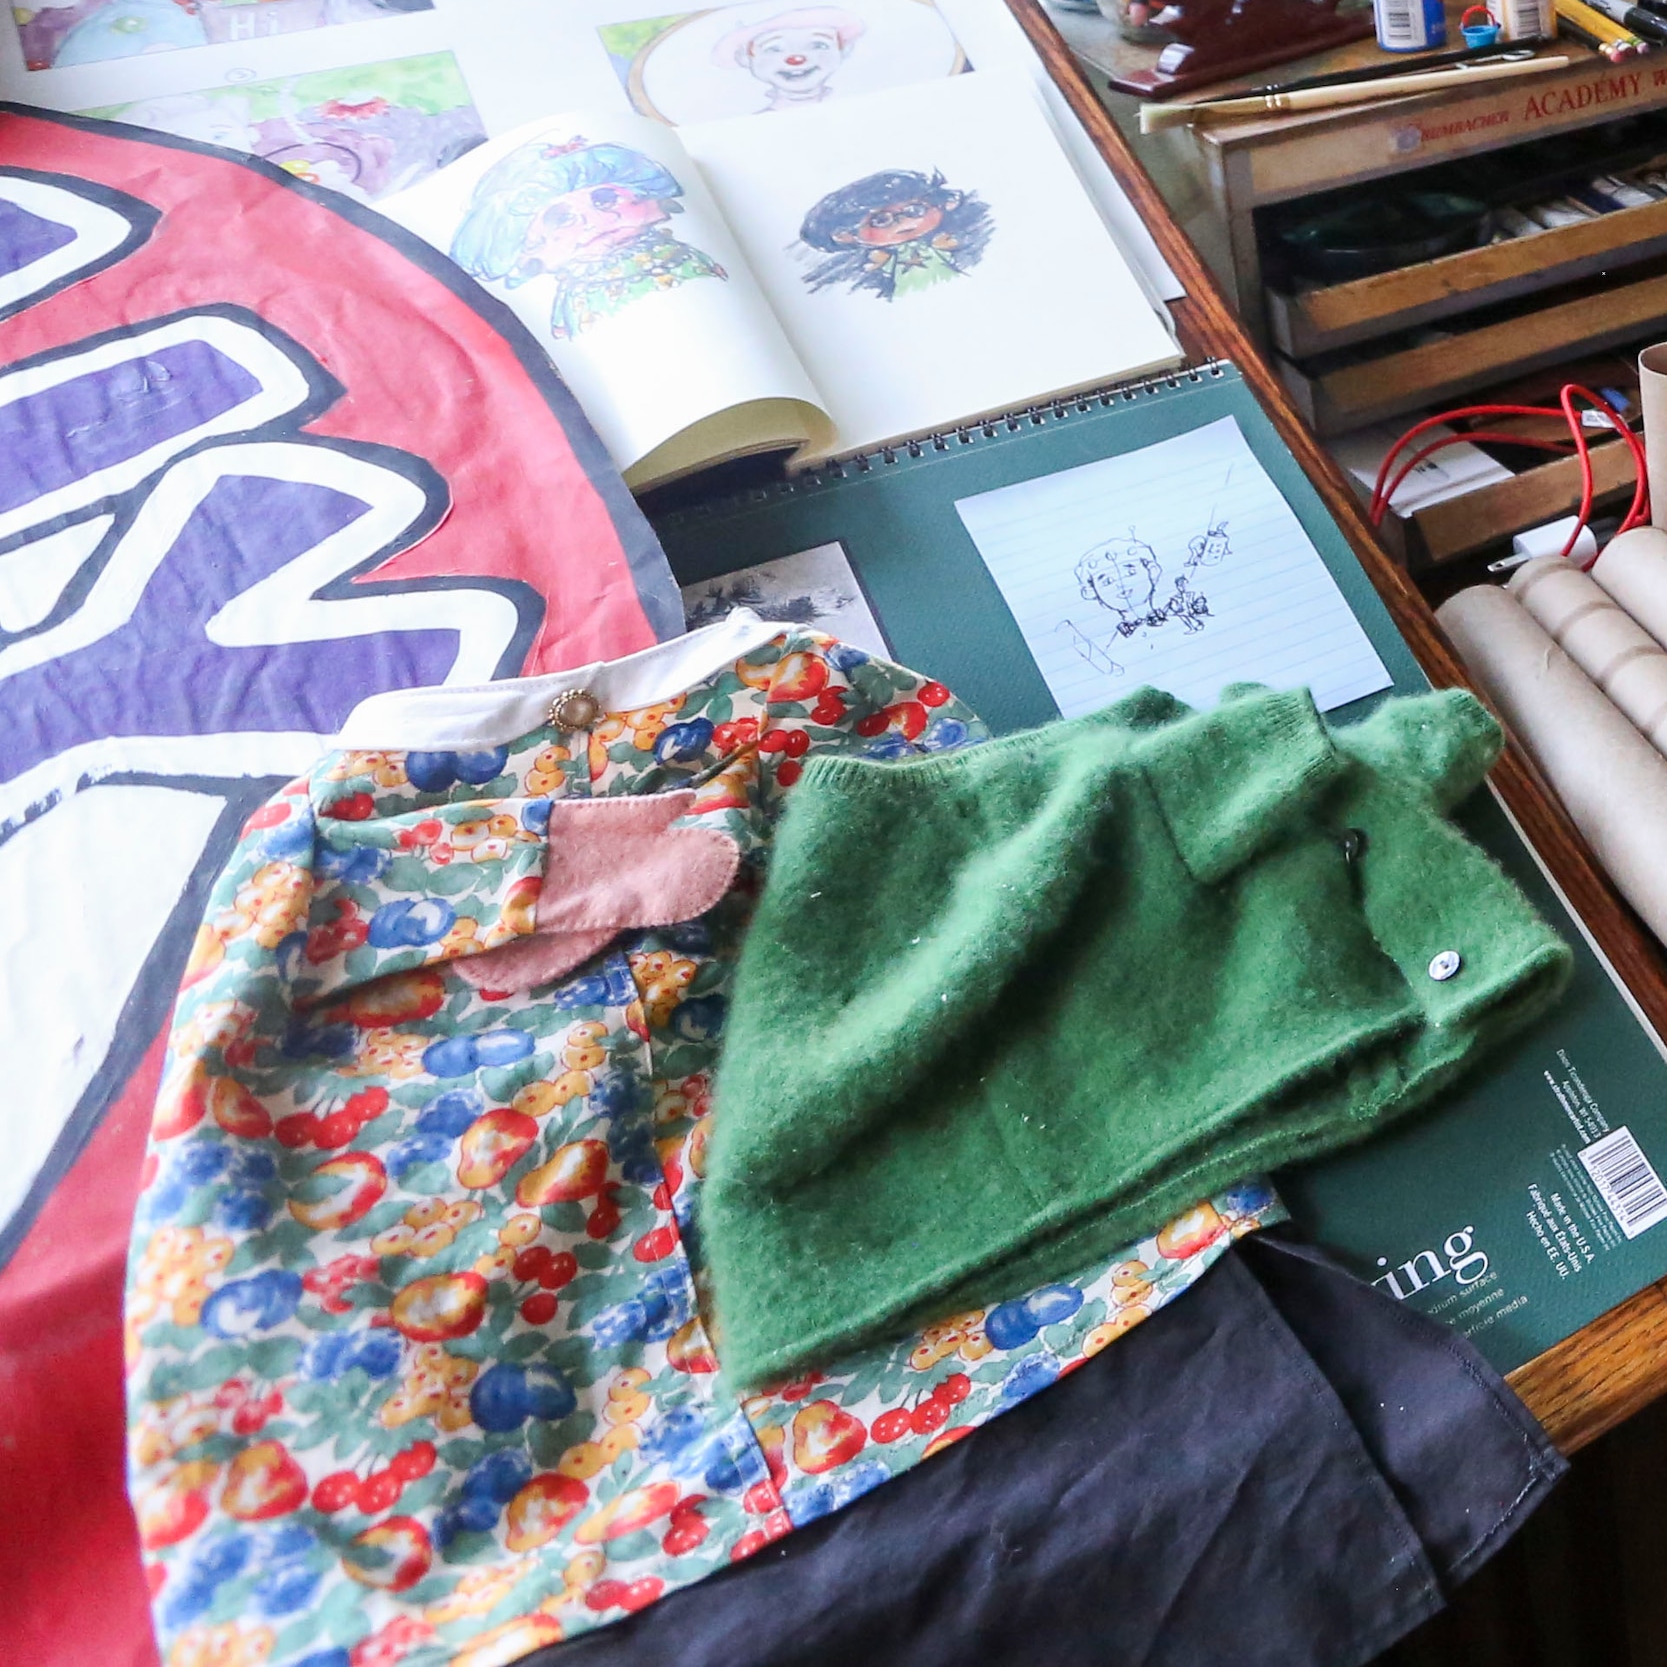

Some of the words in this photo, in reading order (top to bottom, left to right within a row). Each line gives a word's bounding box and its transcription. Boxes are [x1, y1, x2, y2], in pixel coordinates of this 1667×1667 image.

[1525, 1210, 1546, 1237] Hecho
[1539, 1235, 1551, 1248] en
[1545, 1216, 1559, 1232] aux
[1549, 1192, 1567, 1215] Made
[1567, 1223, 1581, 1238] the
[1370, 1225, 1489, 1300] ing
[1459, 1270, 1498, 1297] surface
[1458, 1287, 1505, 1320] moyenne
[1496, 1294, 1529, 1319] media
